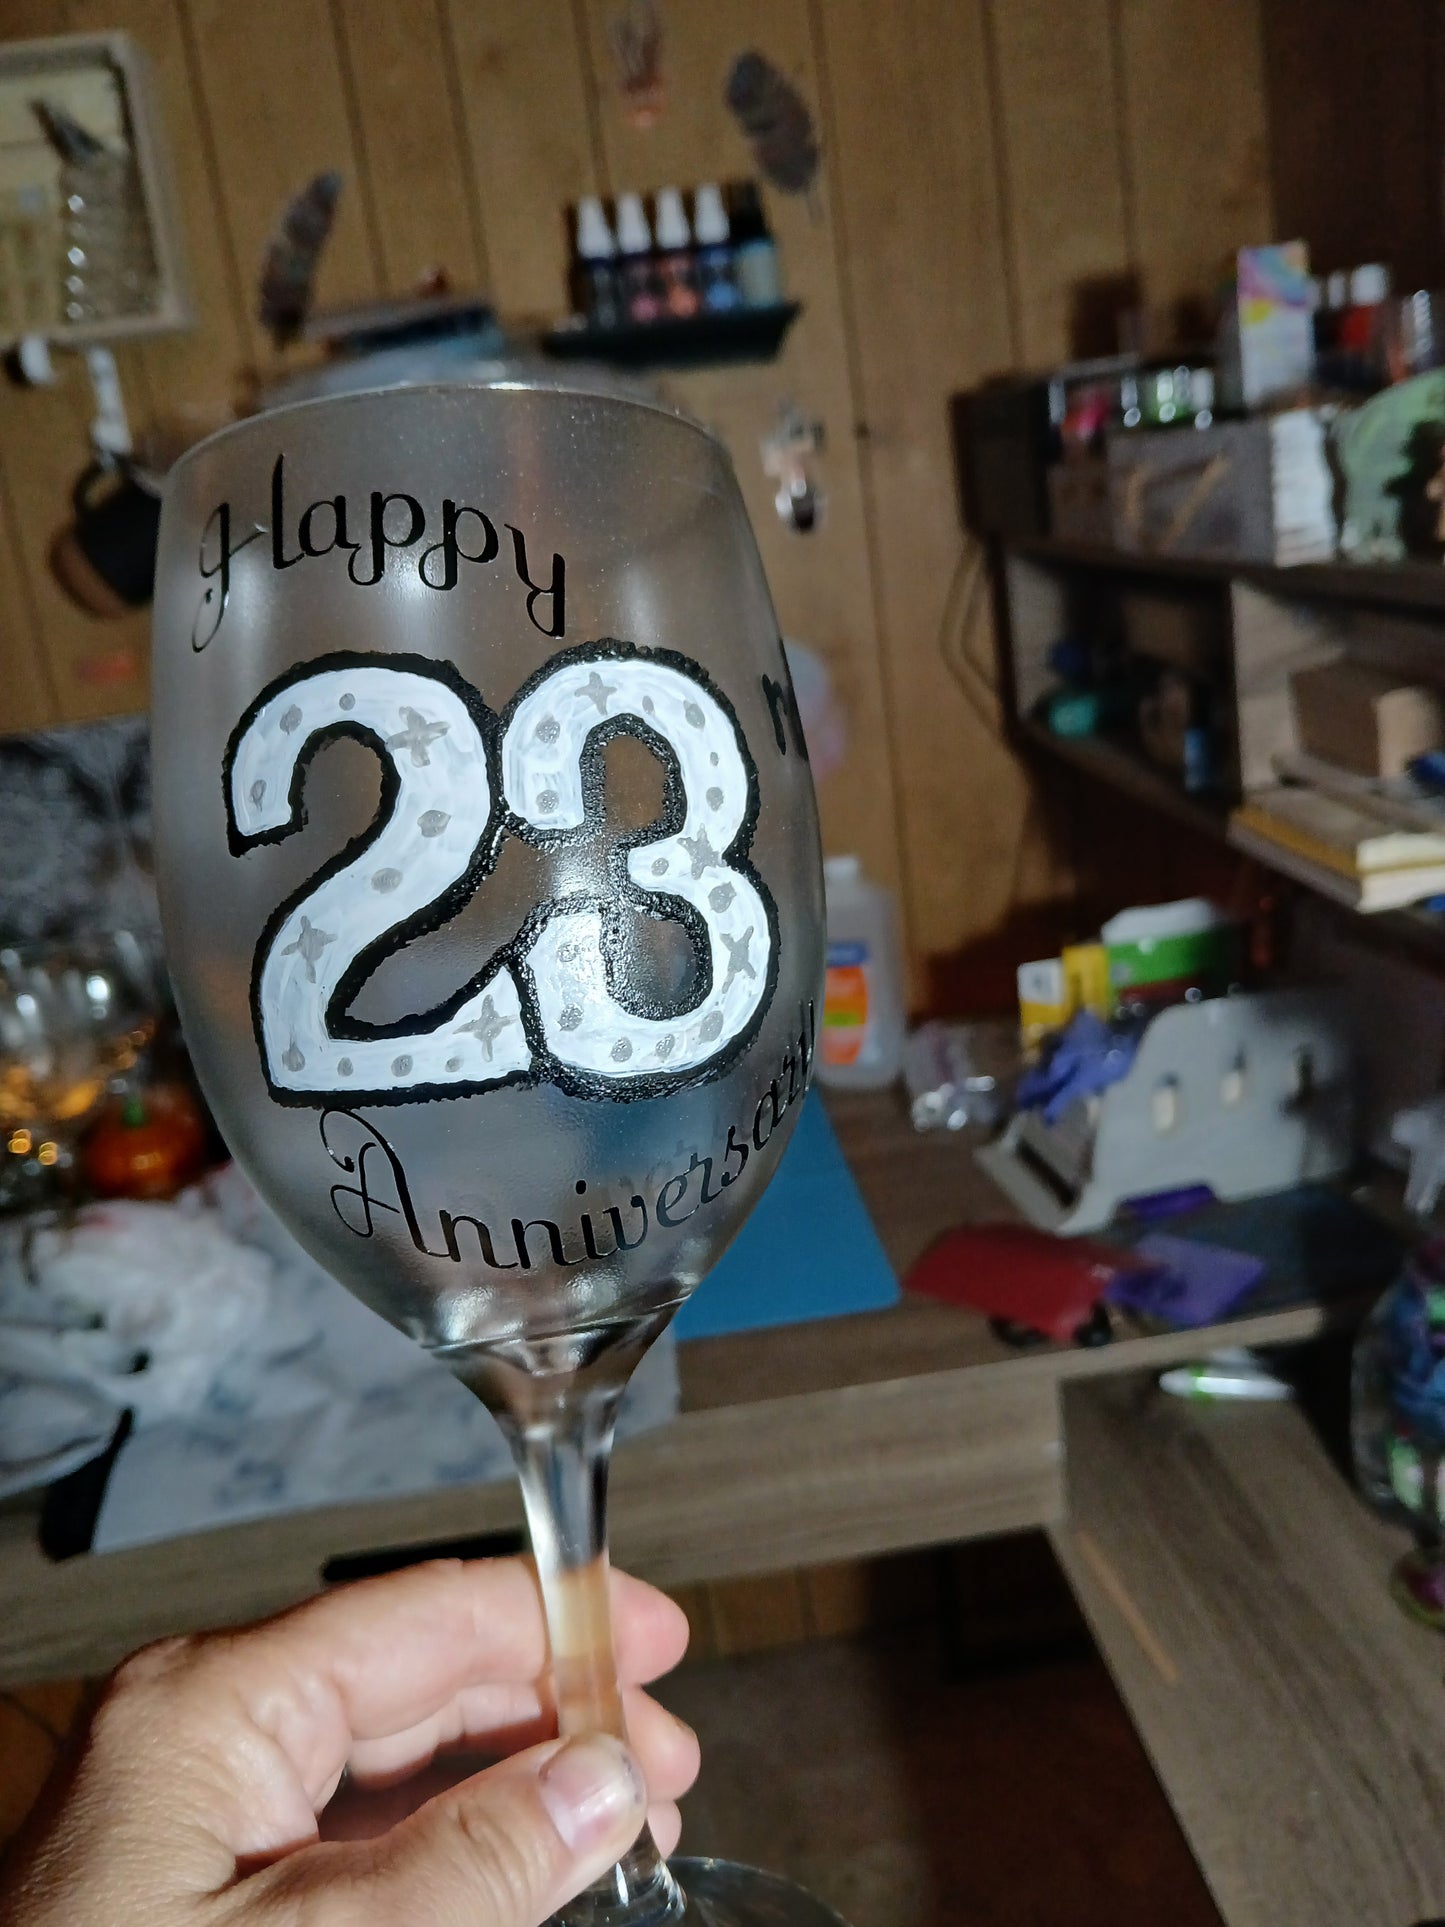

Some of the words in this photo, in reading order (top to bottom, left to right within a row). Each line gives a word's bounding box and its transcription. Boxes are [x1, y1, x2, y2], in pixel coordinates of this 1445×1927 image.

[192, 454, 566, 653] Happy
[223, 638, 779, 1103] 23
[319, 1000, 815, 1270] Anniversary
